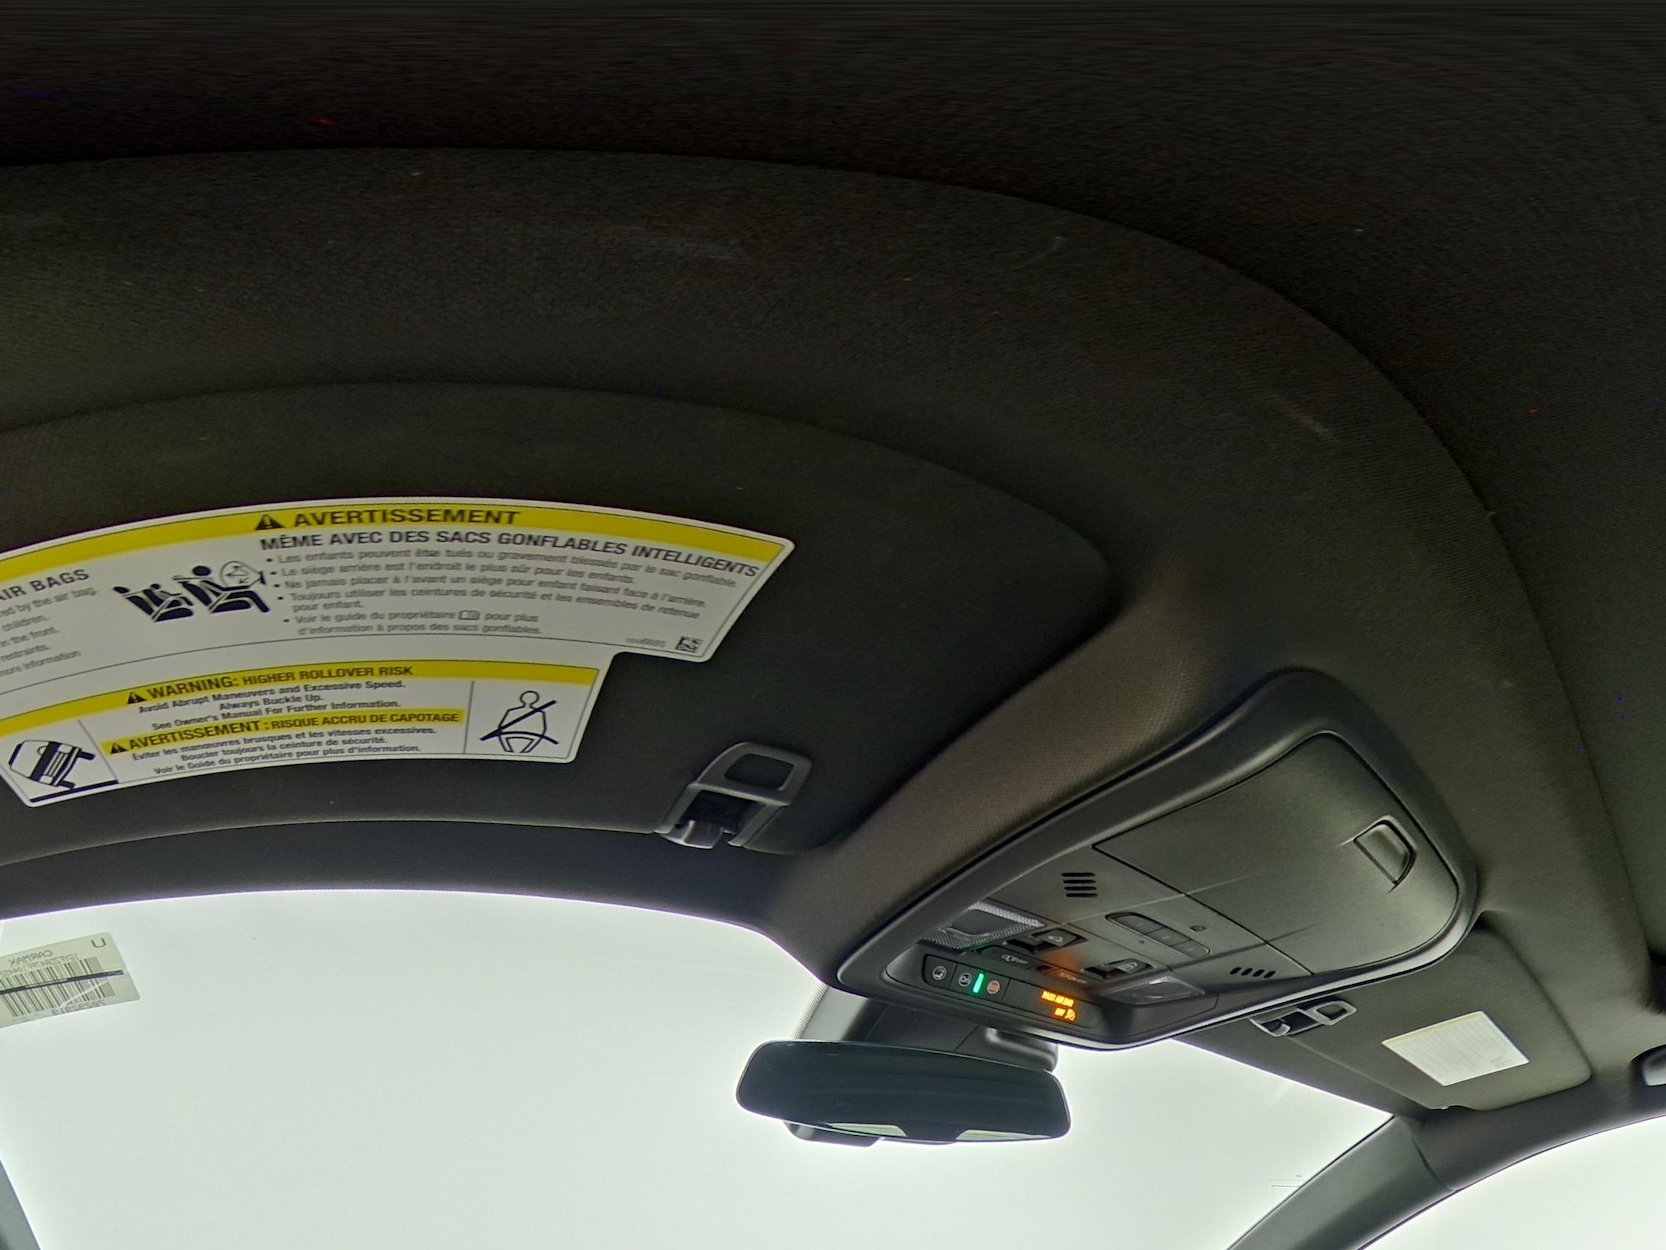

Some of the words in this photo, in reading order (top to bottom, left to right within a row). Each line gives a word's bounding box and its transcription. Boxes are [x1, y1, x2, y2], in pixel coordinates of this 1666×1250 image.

[294, 508, 520, 527] AVERTISSEMENT
[260, 534, 323, 550] MÊME
[330, 532, 382, 544] AVEC
[390, 531, 429, 543] DES
[436, 531, 492, 543] SACS
[497, 533, 627, 555] GONFLABLES
[632, 545, 760, 576] INTELLIGENTS
[29, 569, 90, 592] BAGS
[147, 676, 239, 698] WARNING:
[243, 672, 295, 685] HIGHER
[299, 668, 374, 680] ROLLOVER
[379, 667, 412, 675] RISK
[139, 702, 169, 714] Avoid
[172, 696, 209, 708] Abrupt
[212, 689, 275, 701] Maneuvers
[279, 685, 301, 694] and
[304, 682, 361, 691] Excessive
[365, 681, 405, 689] Speed.
[220, 700, 260, 711] Always
[264, 695, 302, 704] Buckle
[151, 722, 171, 730] See
[174, 715, 219, 726] Owner's
[221, 709, 262, 720] Manual
[265, 706, 282, 714] For
[287, 704, 327, 713] Further
[331, 701, 401, 709] Information.
[129, 721, 260, 750] AVERTISSEMENT
[271, 717, 318, 730] RISQUE
[322, 715, 366, 725] ACCRU
[370, 714, 386, 722] DE
[390, 713, 459, 722] CAPOTAGE
[242, 733, 292, 746] brusques
[328, 728, 371, 737] vitesses
[153, 767, 173, 775] Voir
[187, 760, 215, 770] Guide
[296, 750, 319, 758] pour
[323, 748, 345, 756] plus
[181, 750, 219, 761] Boucler
[222, 743, 265, 756] toujours
[279, 741, 323, 750] ceinture
